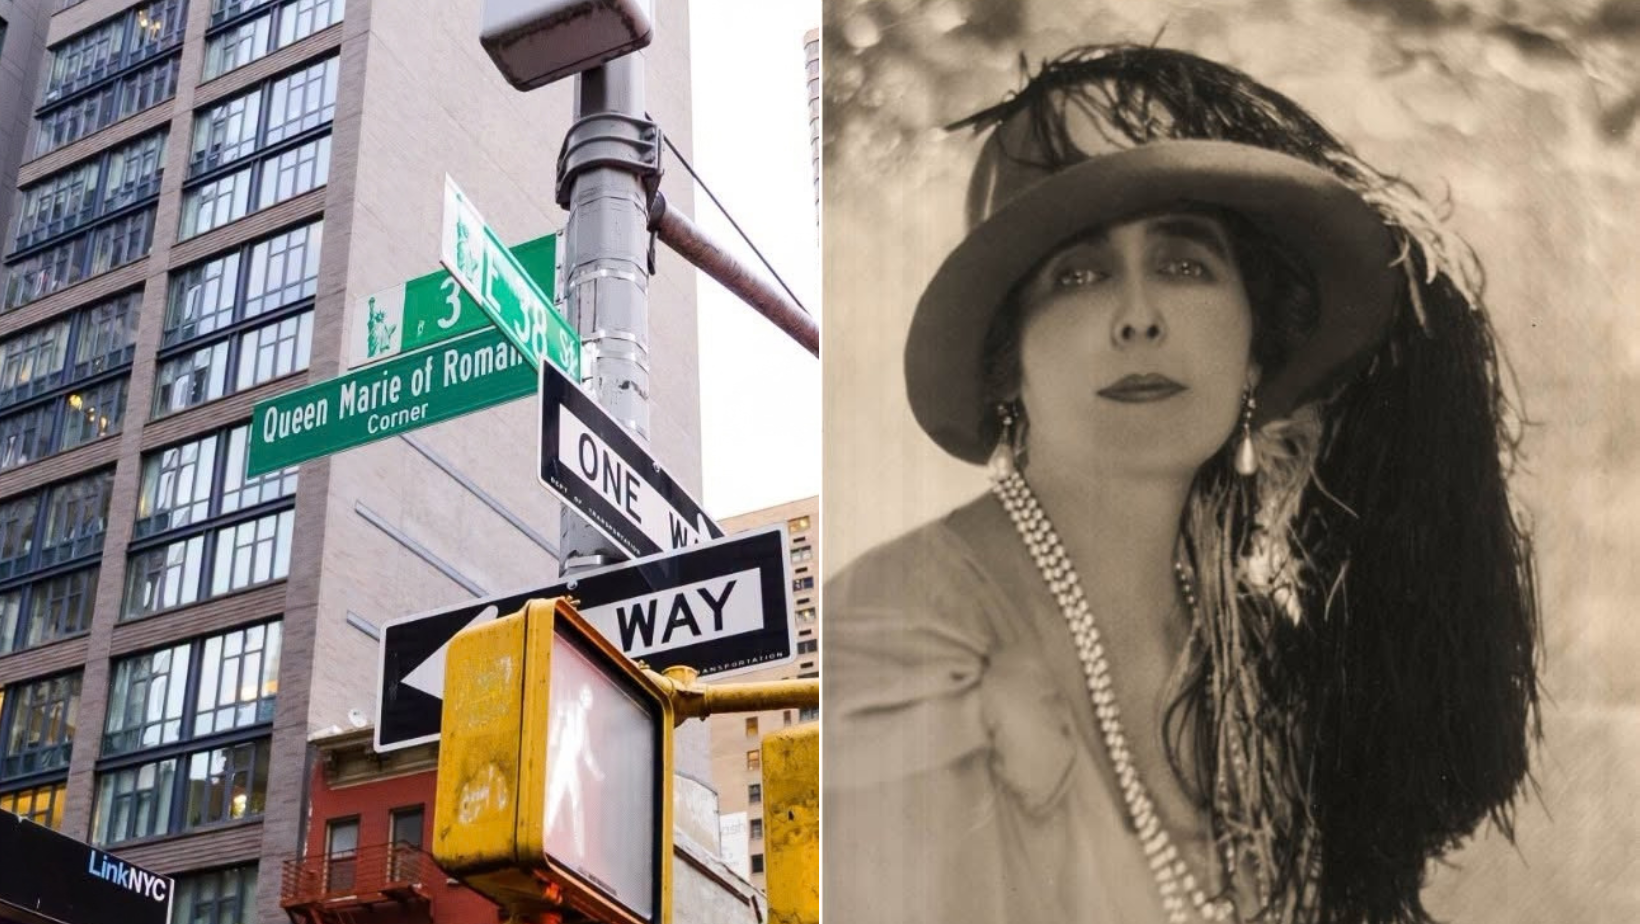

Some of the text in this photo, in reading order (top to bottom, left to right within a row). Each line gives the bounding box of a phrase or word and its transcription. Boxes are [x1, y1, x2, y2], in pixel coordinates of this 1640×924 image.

[437, 276, 462, 329] 3
[485, 243, 577, 376] E 38 St
[262, 341, 523, 443] Queen Marie of Roman
[367, 403, 429, 435] Corner
[550, 476, 568, 494] DEPT
[573, 495, 583, 505] OF
[578, 432, 642, 526] ONE
[616, 579, 737, 653] WAY
[698, 651, 784, 675] ANSPORTATION
[88, 849, 167, 902] LinkNYC
